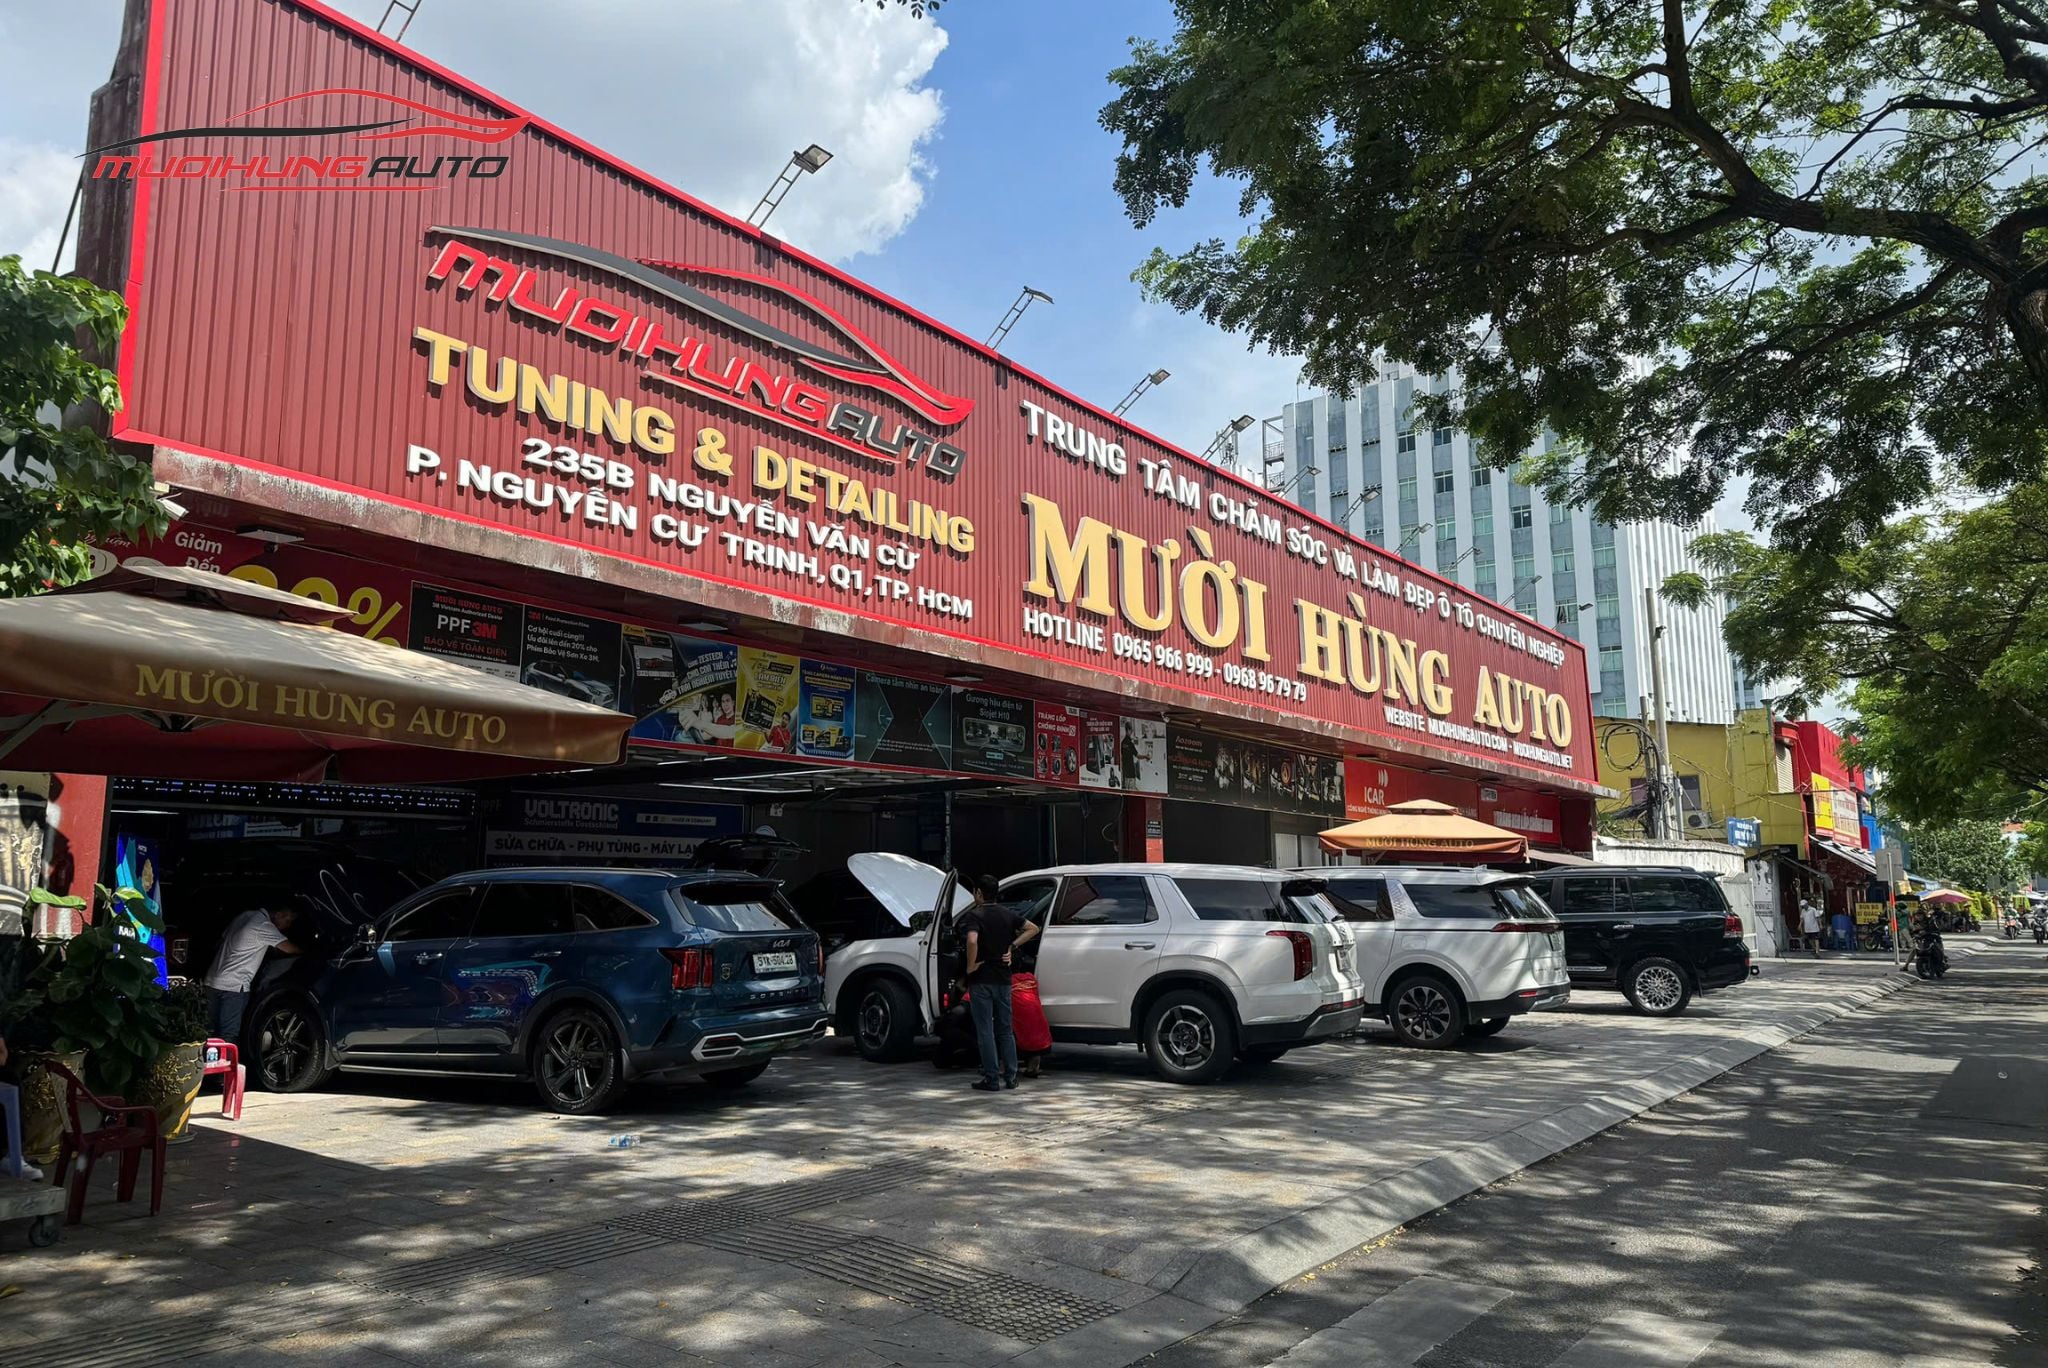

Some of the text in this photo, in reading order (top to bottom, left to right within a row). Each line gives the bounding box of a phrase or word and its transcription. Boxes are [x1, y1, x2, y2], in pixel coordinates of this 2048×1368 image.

[413, 326, 975, 553] TUNING & DETAILING
[407, 443, 447, 481] P.
[457, 459, 638, 530] NGUYỄN
[652, 513, 710, 547] CƯ
[521, 437, 921, 571] 235B NGUYỄN VĂN CỪ
[174, 531, 223, 555] Giảm
[1020, 399, 1565, 670] TRUNG TÂM CHĂM SÓC VÀ LÀM ĐẸP Ô TÔ CHUYÊN NGHIỆP
[437, 613, 497, 640] PPF 3M
[1021, 491, 1572, 748] MƯỜI HÙNG AUTO
[1112, 632, 1152, 664] 0965
[1155, 644, 1183, 672] 966
[1186, 652, 1213, 678] 999
[1223, 662, 1256, 691] 0968
[1258, 672, 1275, 693] 96
[1275, 675, 1291, 698] 79
[1292, 680, 1307, 702] 79
[135, 664, 507, 744] MƯỜI HÙNG AUTO
[524, 799, 619, 822] VOLTRONIC
[1364, 786, 1385, 806] ICAR
[495, 833, 524, 850] SỬA
[528, 836, 566, 851] CHỮA
[577, 841, 603, 855] PHỤ
[607, 840, 641, 853] TÙNG
[651, 841, 675, 854] MÁY
[1440, 839, 1474, 849] AUTO
